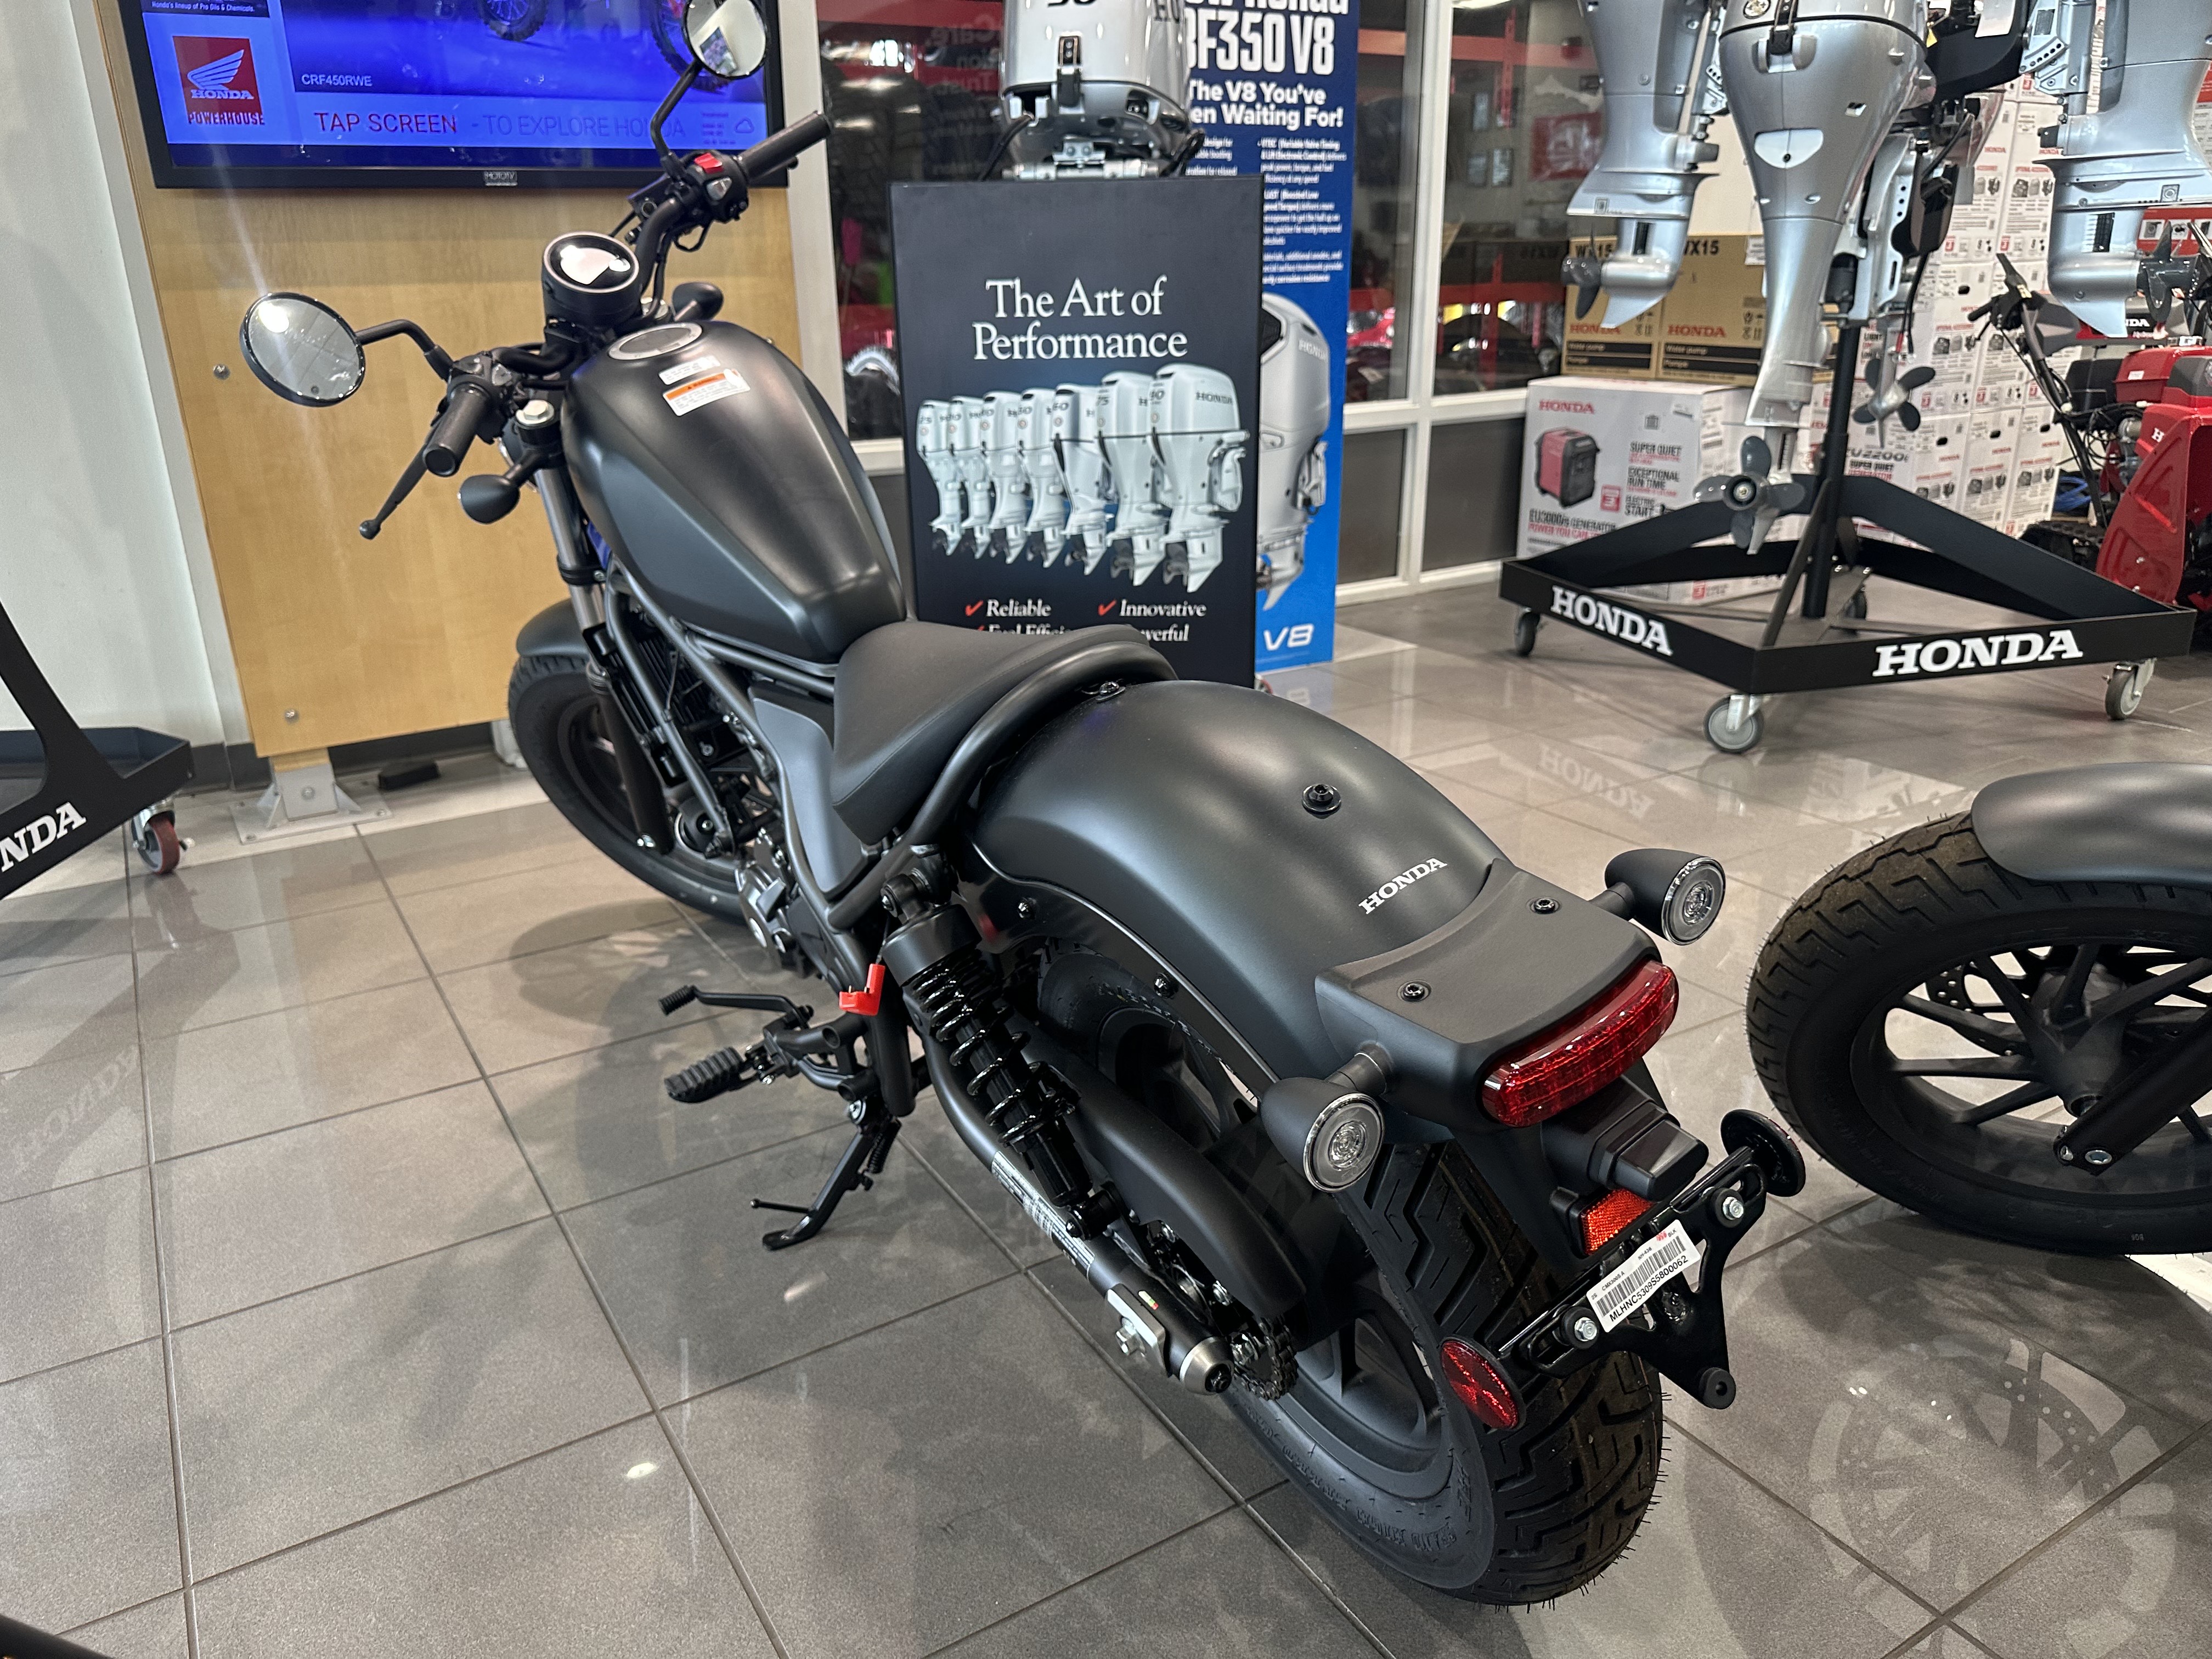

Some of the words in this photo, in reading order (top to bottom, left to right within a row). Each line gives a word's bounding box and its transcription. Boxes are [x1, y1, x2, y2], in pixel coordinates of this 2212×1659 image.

[1290, 14, 1335, 75] V8
[301, 75, 373, 87] CRF450RWE
[190, 89, 255, 100] HONDA
[1189, 80, 1222, 101] The
[1224, 81, 1256, 102] V8
[1259, 83, 1326, 105] You've
[188, 111, 265, 126] POWERHOUSE
[314, 112, 360, 132] TAP
[369, 114, 457, 134] SCREEN
[483, 114, 512, 136] TO
[518, 116, 609, 137] EXPLORE
[1190, 106, 1217, 123] en
[1221, 106, 1299, 131] Waiting
[1305, 108, 1344, 128] For!
[1576, 241, 1612, 258] W15
[986, 278, 1054, 318] The
[1061, 277, 1124, 317] Art
[1133, 275, 1167, 315] of
[972, 321, 1188, 360] Performance
[1668, 326, 1726, 338] HONDA
[1195, 391, 1233, 405] HONDA
[1539, 399, 1594, 414] HONDA
[1630, 441, 1656, 455] SUPER
[1657, 444, 1682, 456] QUIET
[1628, 466, 1680, 483] EXCEPTIONAL
[1628, 476, 1644, 487] RUN
[1646, 478, 1667, 490] TIME
[1624, 504, 1654, 517] START
[986, 599, 1051, 617] Reliable
[1120, 599, 1207, 617] Innovative
[1550, 586, 1674, 657] HONDA
[1141, 624, 1189, 641] werful
[1263, 624, 1314, 651] V8
[1872, 629, 2083, 678] HONDA
[0, 802, 87, 873] NDA
[1358, 857, 1448, 915] HONDA
[1610, 1255, 1689, 1322] MLHNC5309S5800062
